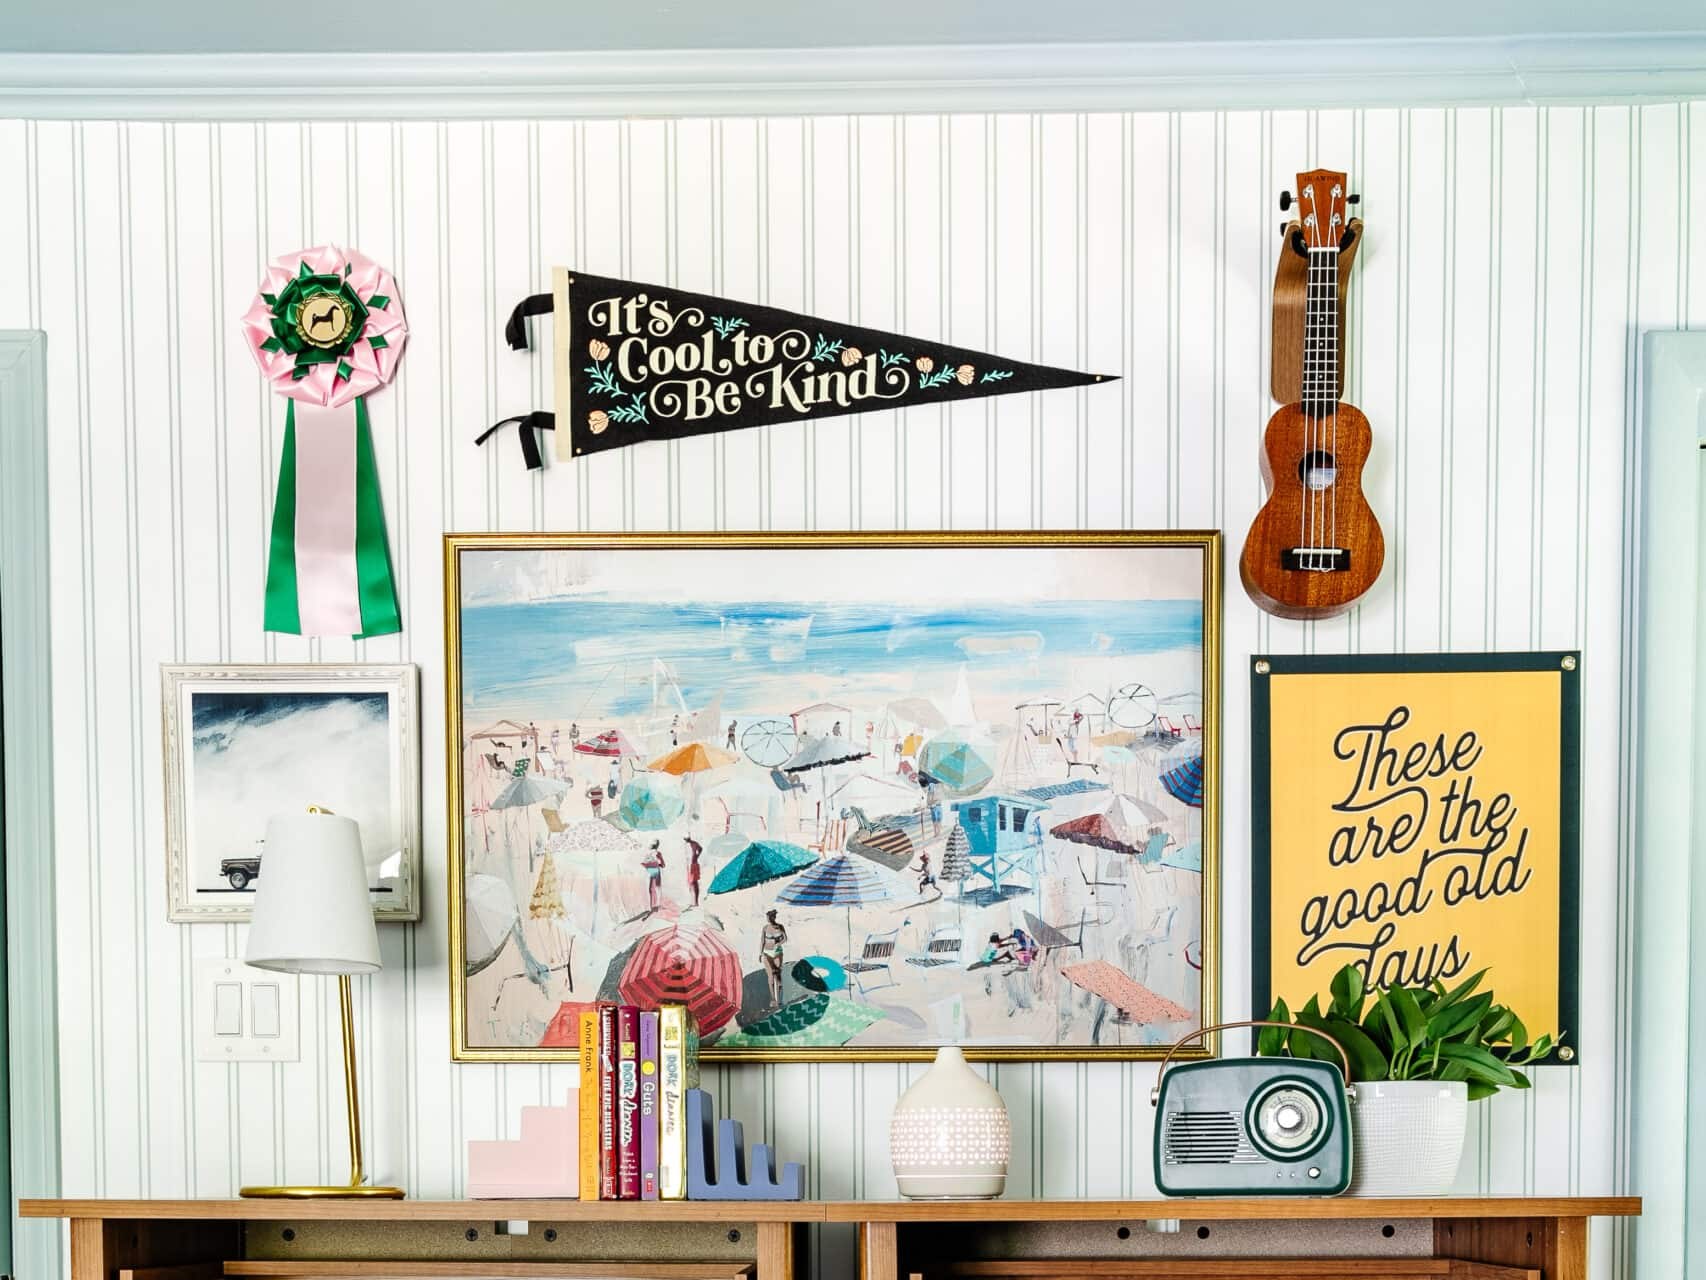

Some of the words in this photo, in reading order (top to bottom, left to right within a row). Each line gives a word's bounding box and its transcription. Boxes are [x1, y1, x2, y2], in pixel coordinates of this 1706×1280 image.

[588, 294, 704, 337] It's
[617, 331, 732, 384] Cool
[731, 328, 811, 365] to
[649, 379, 742, 421] Be
[745, 353, 910, 413] Kind
[1332, 705, 1483, 812] These
[1328, 795, 1429, 867] are
[1439, 775, 1517, 843] the
[1296, 849, 1433, 966] good
[1442, 827, 1532, 906] old
[1352, 922, 1470, 996] days
[585, 1020, 593, 1045] Anne
[585, 1047, 593, 1073] Frank
[643, 1082, 655, 1115] Guts
[666, 1055, 678, 1087] DORK
